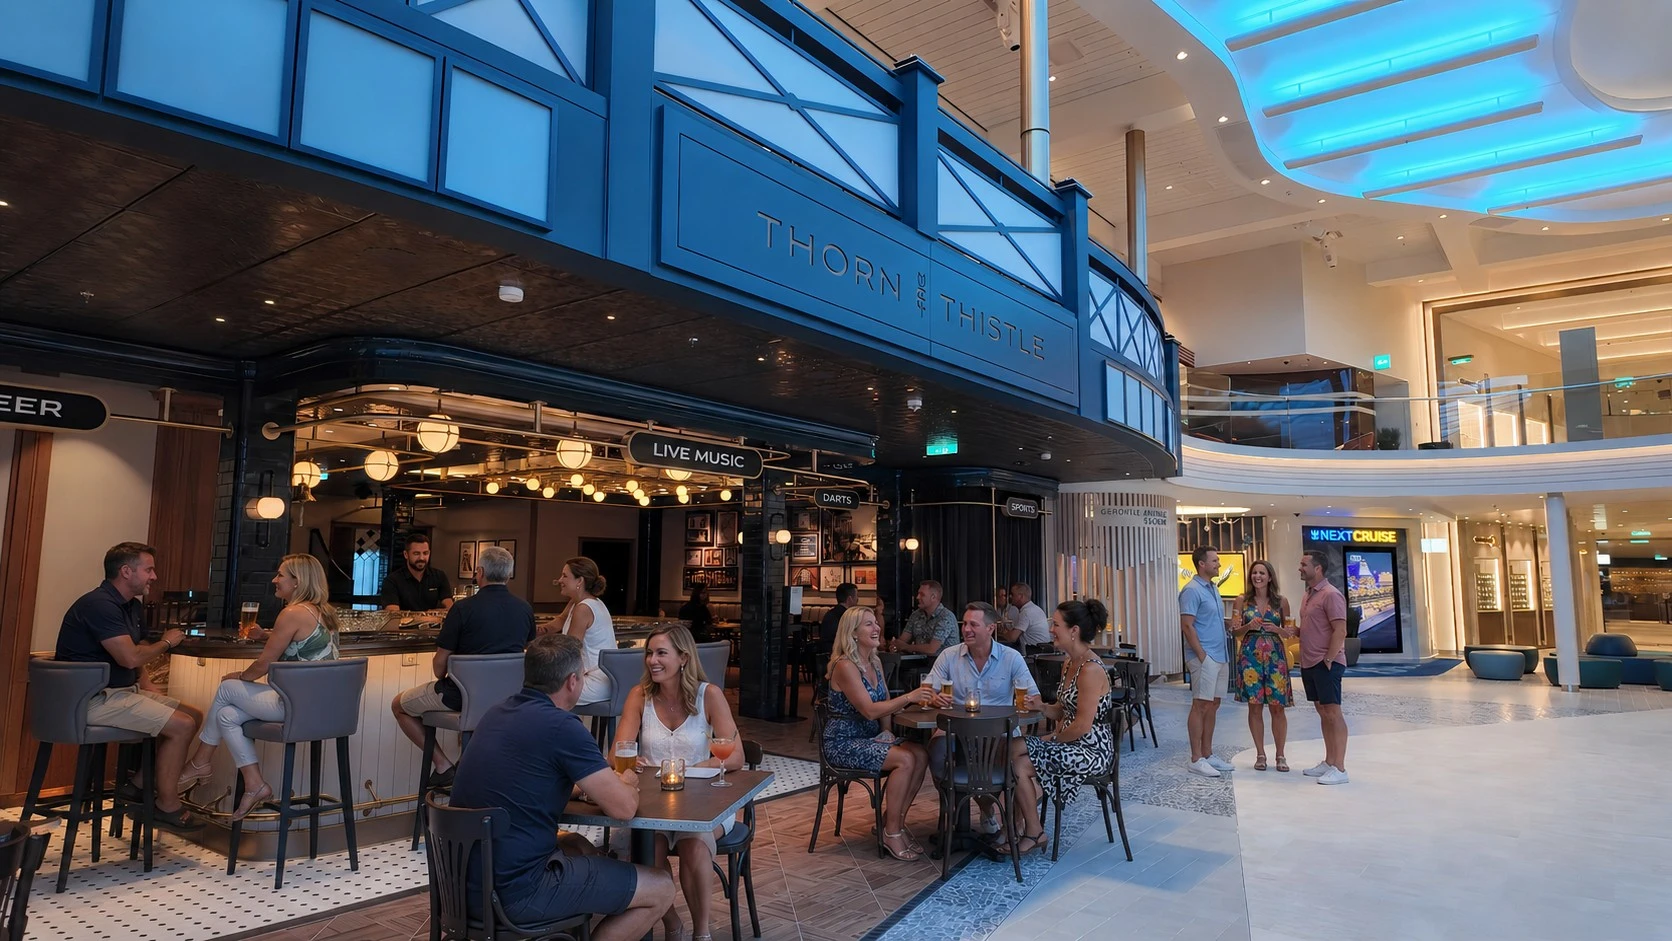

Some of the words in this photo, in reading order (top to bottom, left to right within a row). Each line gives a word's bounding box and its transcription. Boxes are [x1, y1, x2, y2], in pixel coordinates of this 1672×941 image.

[757, 210, 901, 302] THORN
[940, 293, 1045, 361] THISTLE
[653, 442, 690, 460] LIVE
[694, 449, 745, 468] MUSIC
[823, 493, 852, 505] DARTS
